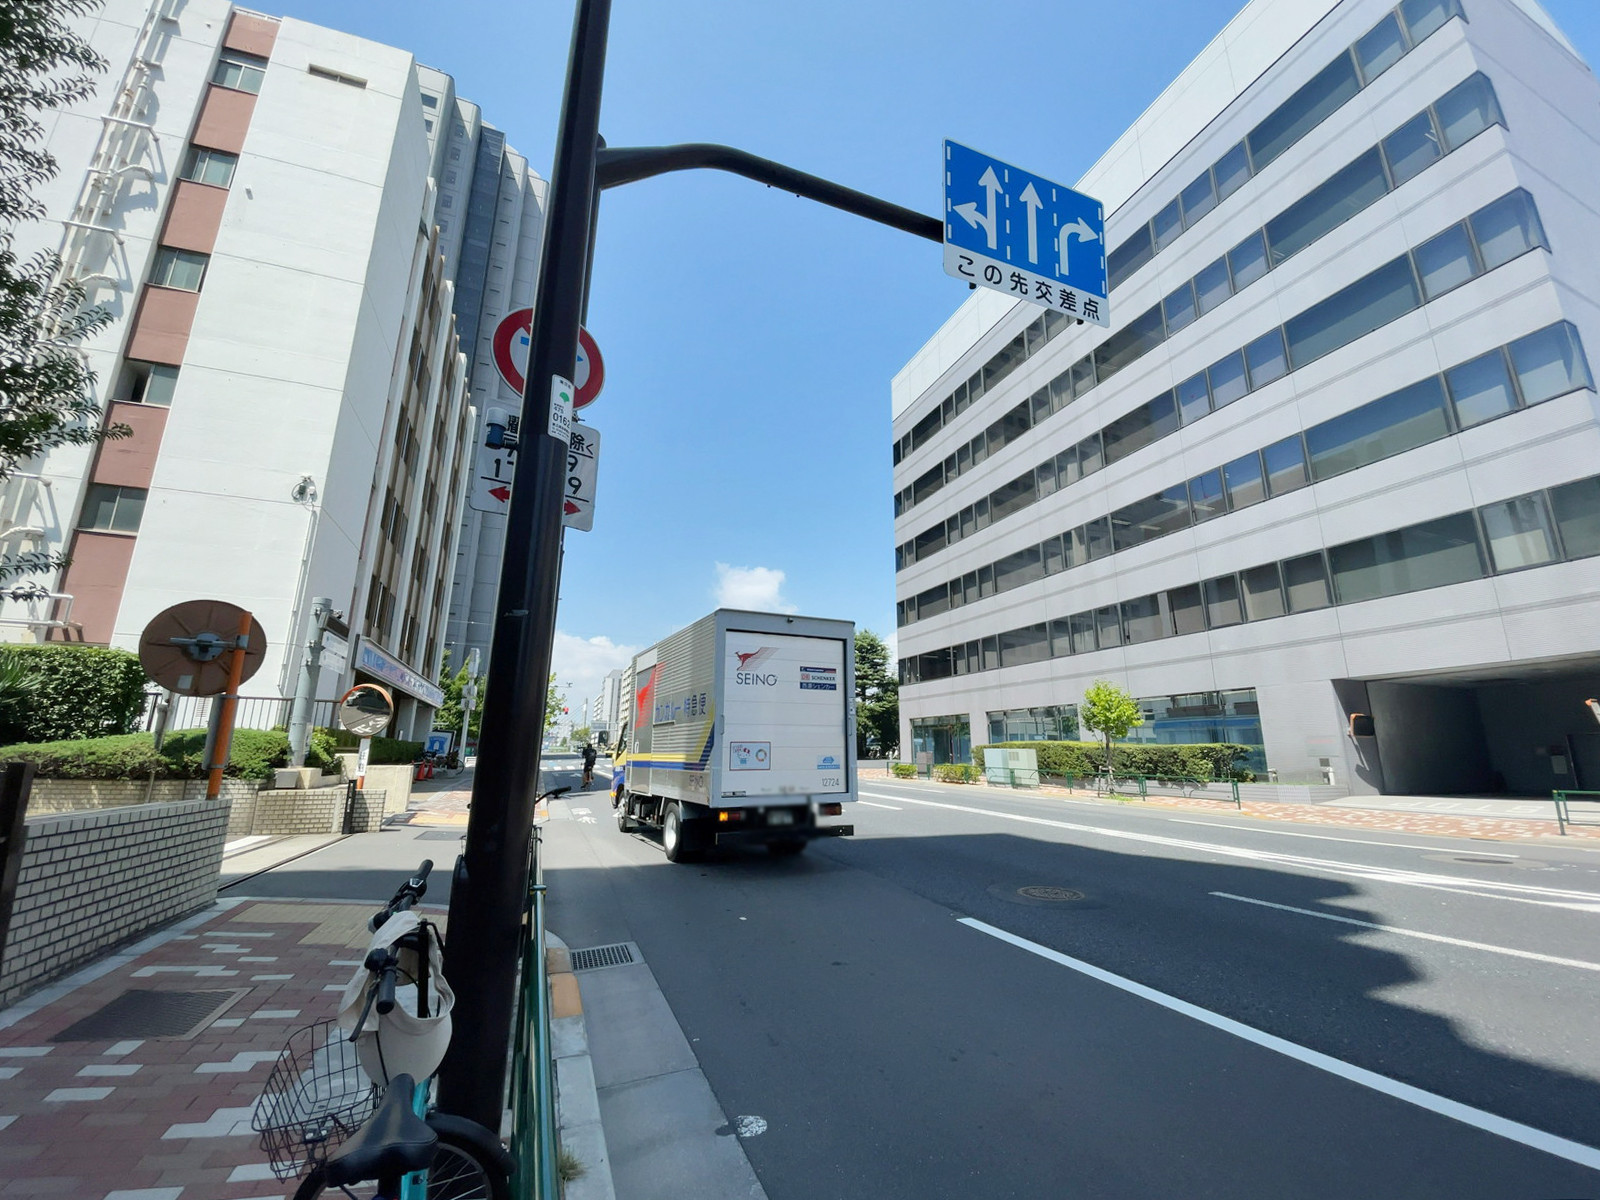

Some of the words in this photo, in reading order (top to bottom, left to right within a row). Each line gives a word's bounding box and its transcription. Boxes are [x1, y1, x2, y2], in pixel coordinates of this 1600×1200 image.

[957, 254, 1101, 321] この先交差点
[552, 412, 571, 429] 0162
[569, 432, 594, 455] 除く
[736, 672, 777, 687] SEINO
[821, 777, 840, 787] 12724
